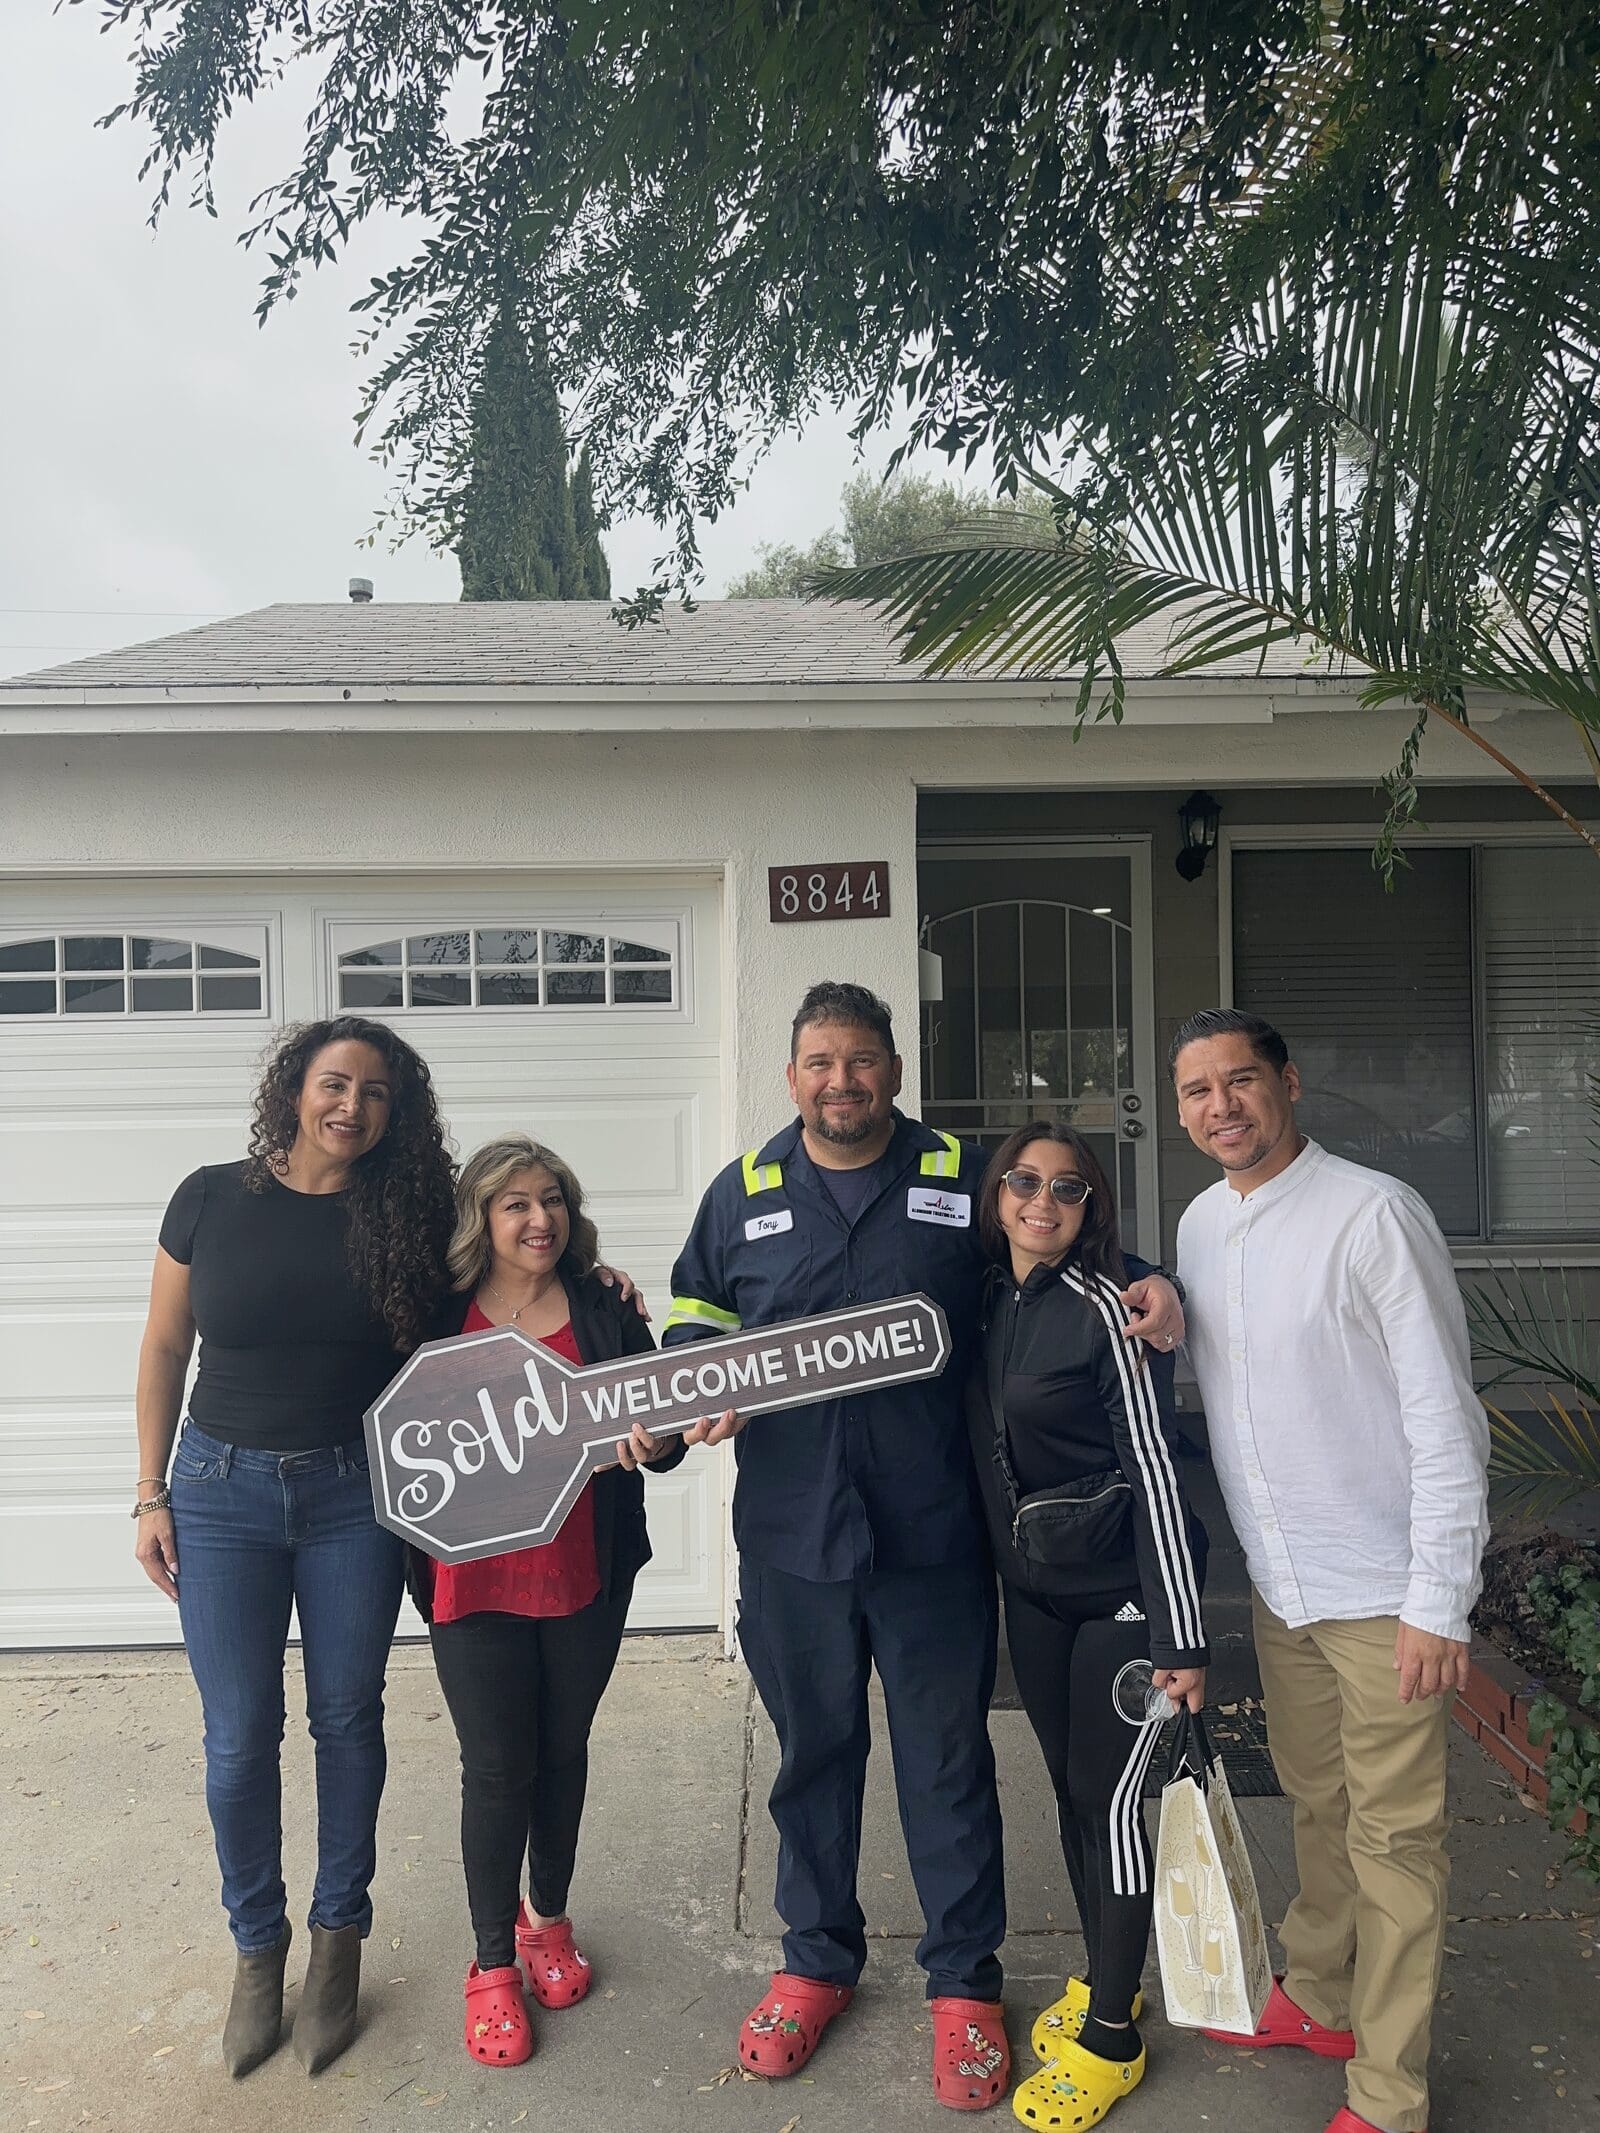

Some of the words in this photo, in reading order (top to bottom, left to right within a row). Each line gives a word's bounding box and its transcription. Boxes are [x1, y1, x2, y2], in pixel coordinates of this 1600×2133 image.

[780, 870, 880, 915] 8844
[758, 1220, 778, 1231] Tony
[581, 1347, 788, 1423] WELCOME
[795, 1318, 926, 1378] HOME!
[390, 1357, 567, 1523] Sold
[1114, 1613, 1146, 1622] adidas
